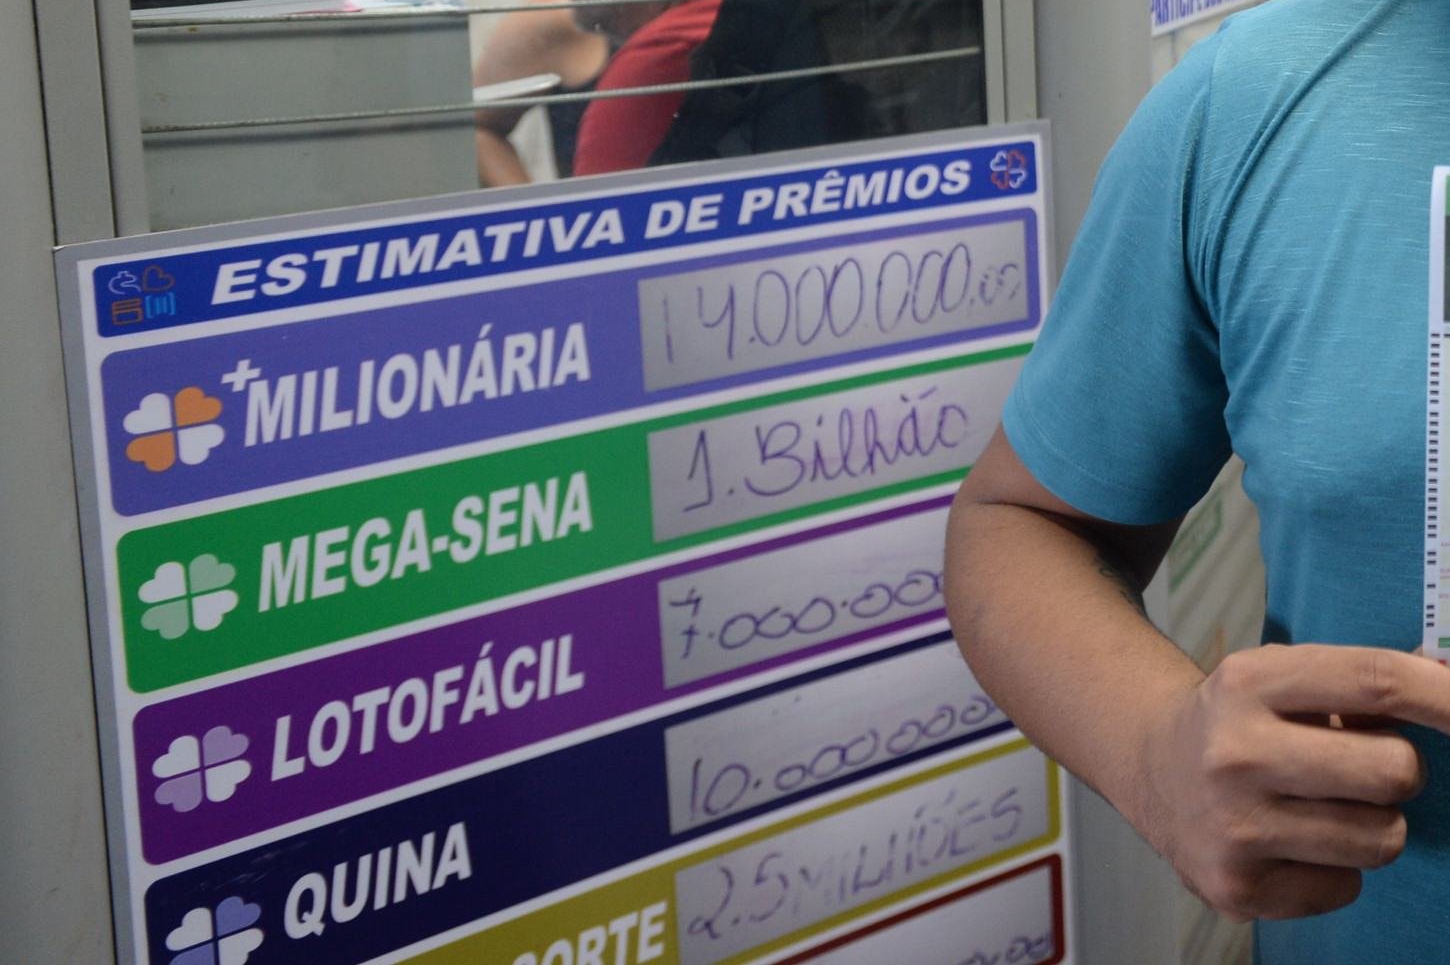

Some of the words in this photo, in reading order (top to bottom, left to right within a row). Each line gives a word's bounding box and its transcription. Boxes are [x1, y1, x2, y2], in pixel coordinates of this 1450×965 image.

[211, 208, 624, 305] ESTIMATIVA
[644, 194, 724, 240] DE
[737, 159, 971, 225] PRÊMIOS
[257, 471, 593, 613] MEGA-SENA
[270, 634, 586, 782] LOTOFÁCIL
[283, 821, 473, 940] QUINA
